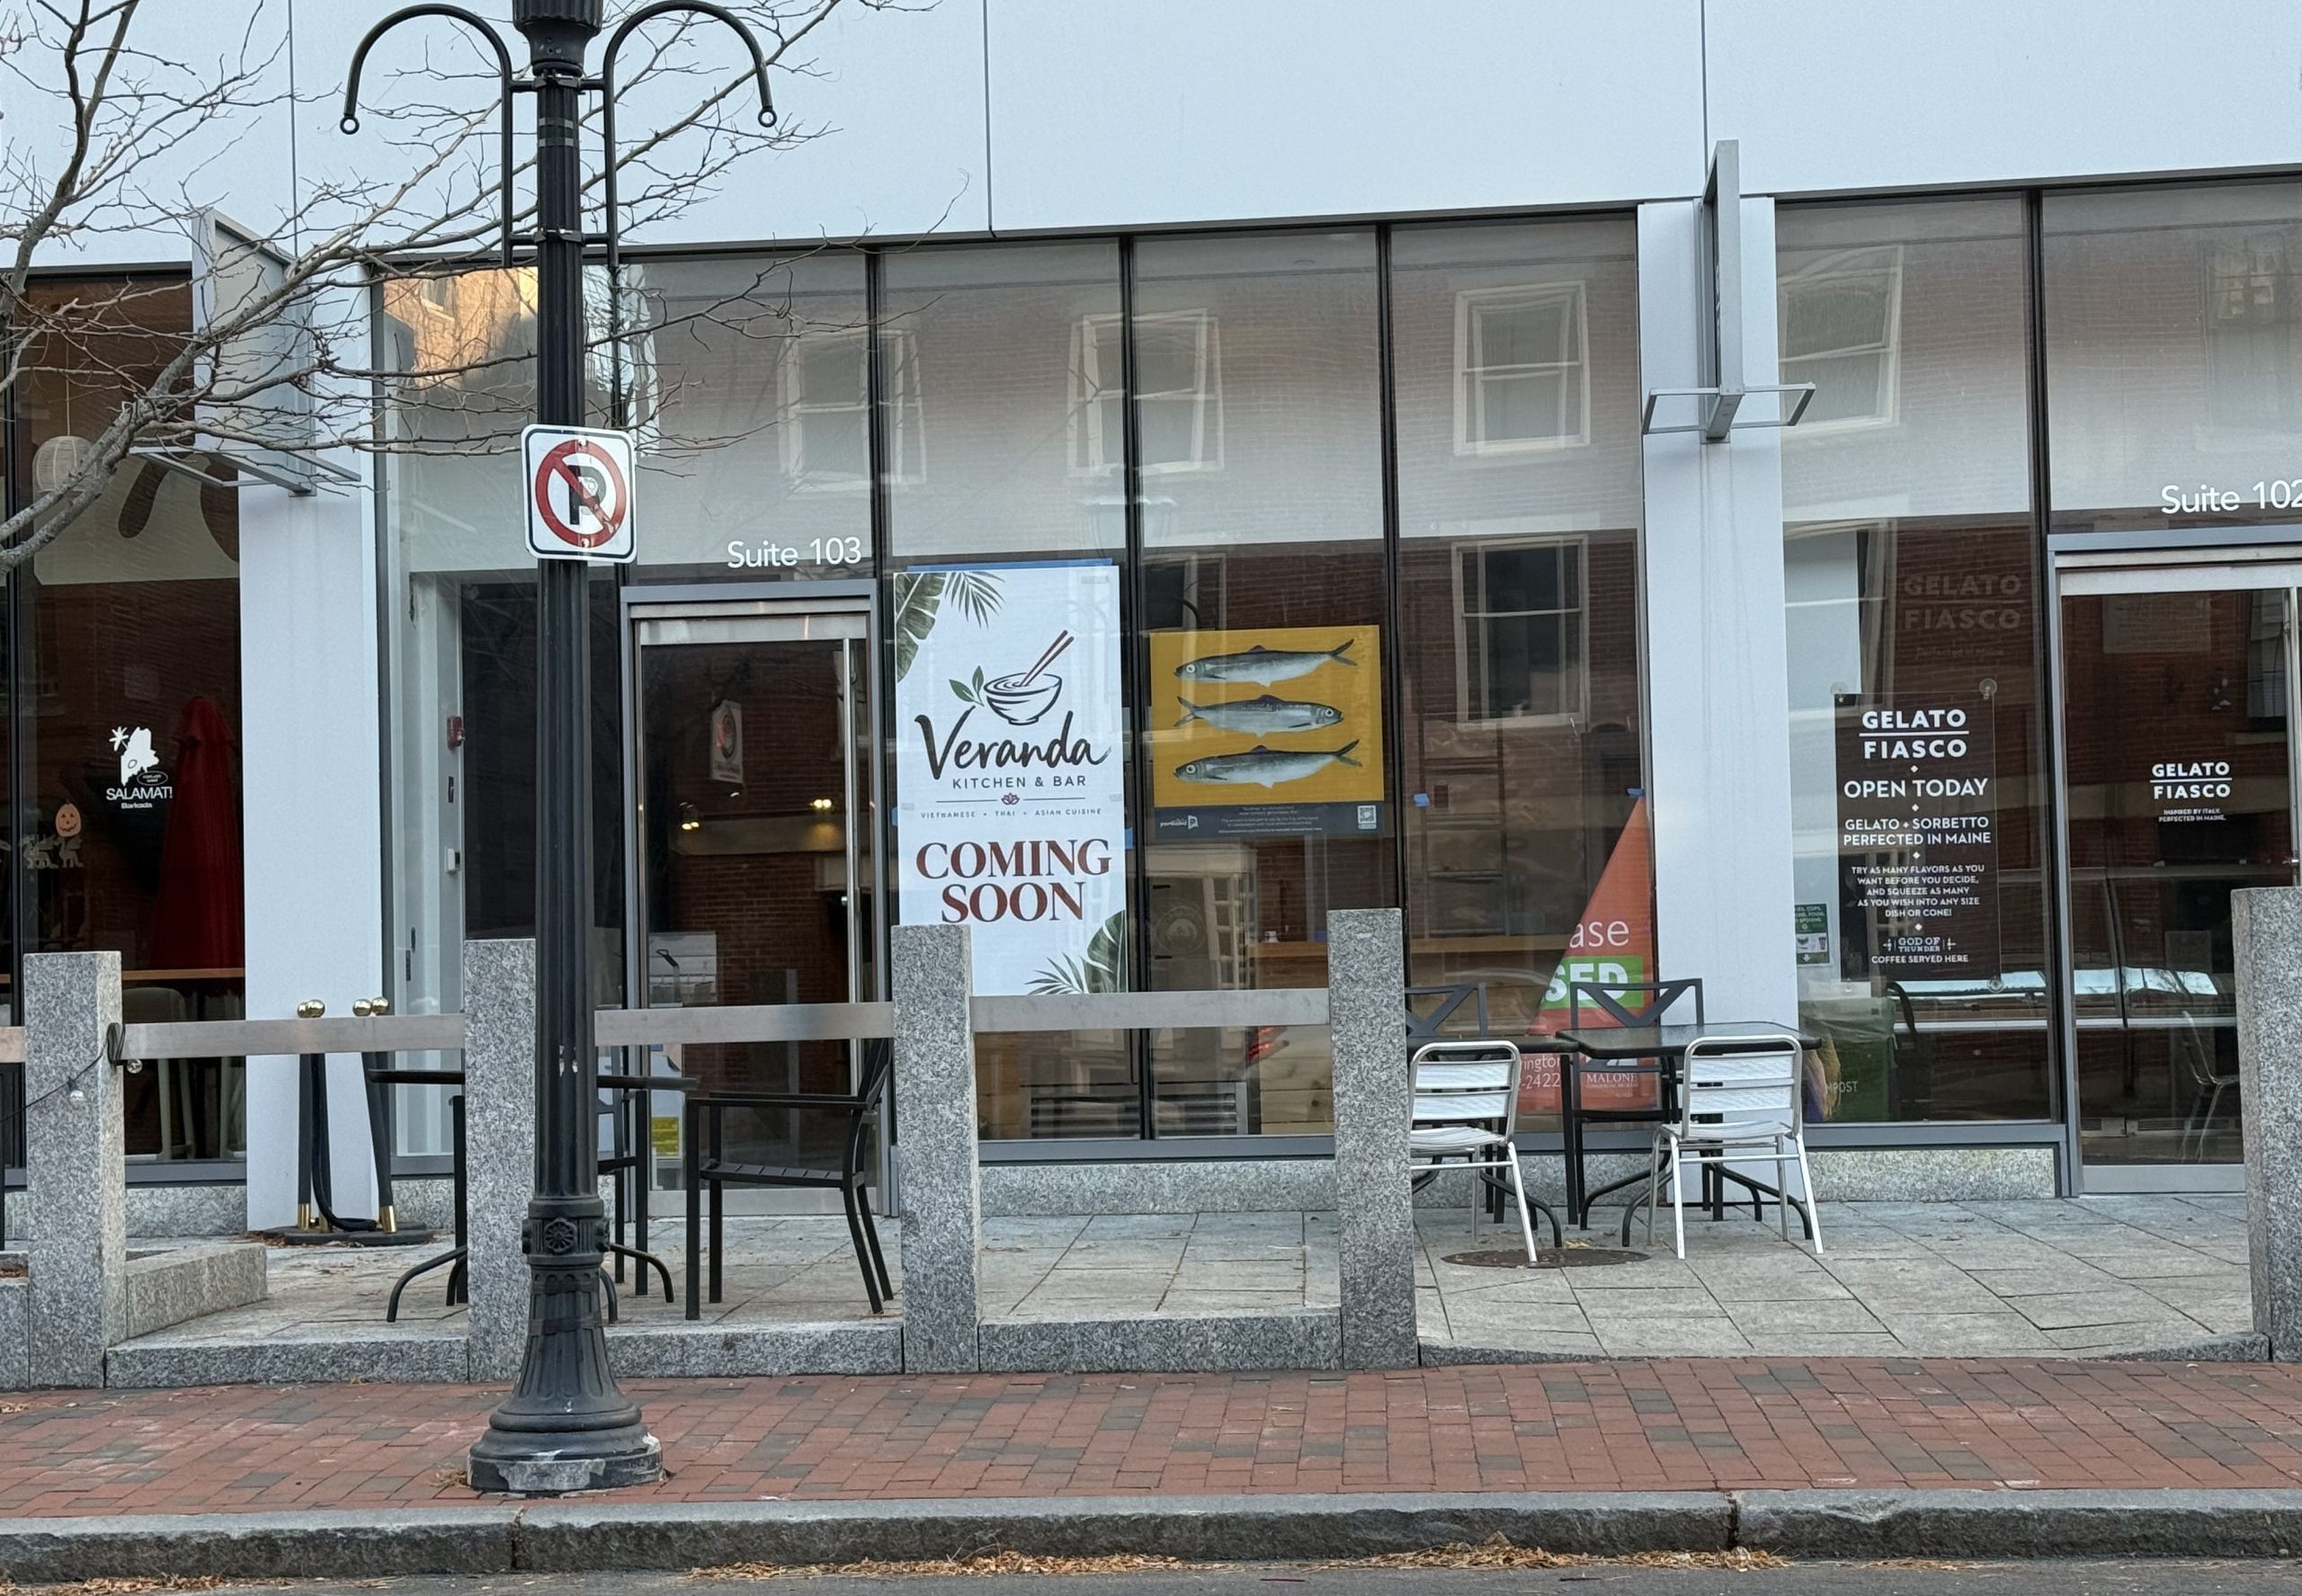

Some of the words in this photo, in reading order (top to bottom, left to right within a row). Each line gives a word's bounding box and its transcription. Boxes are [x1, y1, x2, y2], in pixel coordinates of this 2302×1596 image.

[2161, 484, 2241, 513] Suite
[2252, 478, 2302, 510] 102
[727, 540, 799, 568] Suite
[809, 537, 861, 566] 103
[1904, 575, 2022, 596] GELATO
[1905, 608, 2021, 629] FIASCO
[1862, 709, 1967, 729] GELATO
[914, 705, 1112, 780] Veranda
[1864, 738, 1967, 759] FIASCO
[2152, 762, 2230, 777] GELATO
[952, 777, 1026, 789] KITCHEN
[1034, 776, 1044, 788] &
[1053, 775, 1086, 787] BAR
[1843, 780, 1906, 798] OPEN
[1912, 778, 1989, 798] TODAY
[106, 787, 173, 800] SALAMAT!
[2154, 784, 2231, 799] FIASCO
[1845, 818, 1900, 831] GELATO
[1912, 816, 1989, 830] SORBETTO
[1843, 834, 1924, 846] PERFECTED
[1927, 833, 1942, 844] IN
[1946, 832, 1992, 844] MAINE
[915, 838, 1112, 879] COMING
[1870, 866, 1881, 874] AS
[1882, 866, 1908, 874] MANY
[1910, 865, 1950, 874] FLAVORS
[1952, 865, 1964, 873] AS
[1965, 864, 1985, 873] YOU
[1857, 877, 1883, 885] WANT
[1885, 877, 1920, 885] BEFORE
[1921, 876, 1941, 884] YOU
[1867, 887, 1886, 896] AND
[1887, 887, 1928, 896] SQUEEZE
[1930, 887, 1941, 895] AS
[1943, 887, 1969, 895] MANY
[941, 881, 1086, 923] SOON
[1870, 898, 1889, 906] YOU
[1891, 898, 1914, 906] WISH
[1916, 898, 1938, 906] INTO
[1940, 897, 1958, 905] ANY
[1960, 897, 1980, 905] SIZE
[1907, 909, 1921, 917] OR
[1923, 908, 1952, 916] CONE!
[1898, 937, 1923, 946] GOD
[1924, 937, 1941, 945] OF
[1871, 956, 1906, 964] COFFEE
[1908, 955, 1942, 963] SERVED
[1944, 955, 1968, 963] HERE
[1586, 1073, 1637, 1083] MALONE
